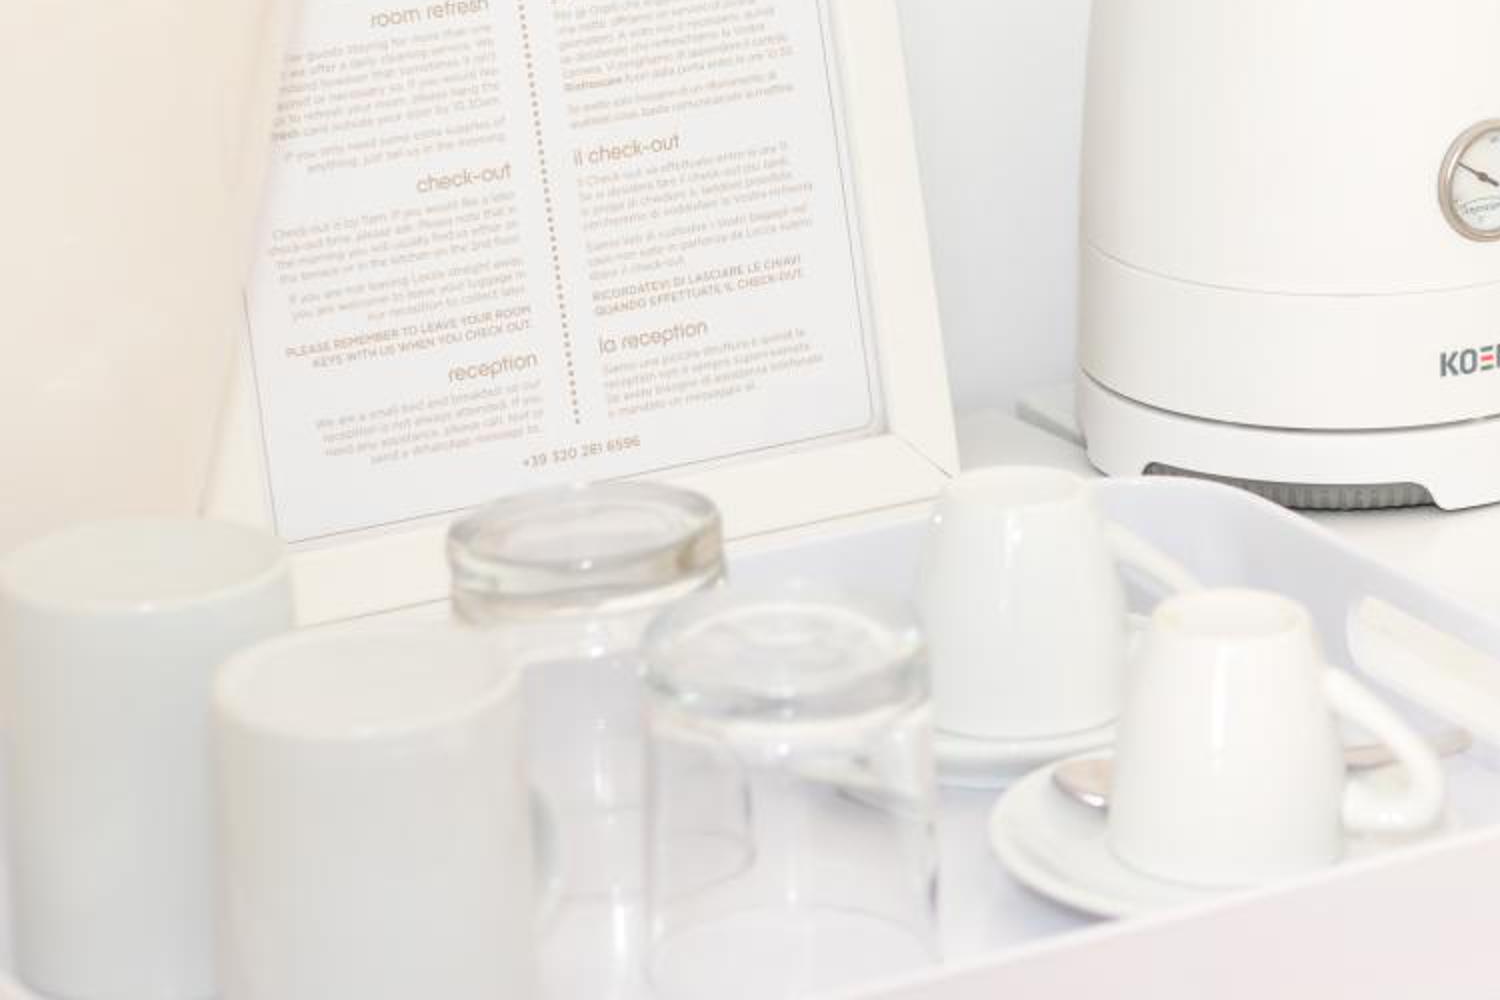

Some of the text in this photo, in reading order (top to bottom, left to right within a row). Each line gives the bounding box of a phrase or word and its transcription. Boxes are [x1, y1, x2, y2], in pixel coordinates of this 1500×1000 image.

[369, 6, 421, 28] room
[586, 135, 680, 164] check-out
[415, 163, 512, 193] check-out
[688, 264, 744, 284] LASCIARE
[593, 297, 646, 316] QUANDO
[284, 303, 532, 358] PLEASE REMEMBER TO LEAVE YOUR ROOM
[597, 318, 709, 354] la reception
[311, 353, 343, 369] KEYS
[346, 347, 378, 362] WITH
[378, 343, 396, 357] US
[397, 336, 435, 353] WHEN
[437, 332, 460, 346] YOU
[464, 324, 503, 341] CHECK
[446, 351, 538, 385] reception
